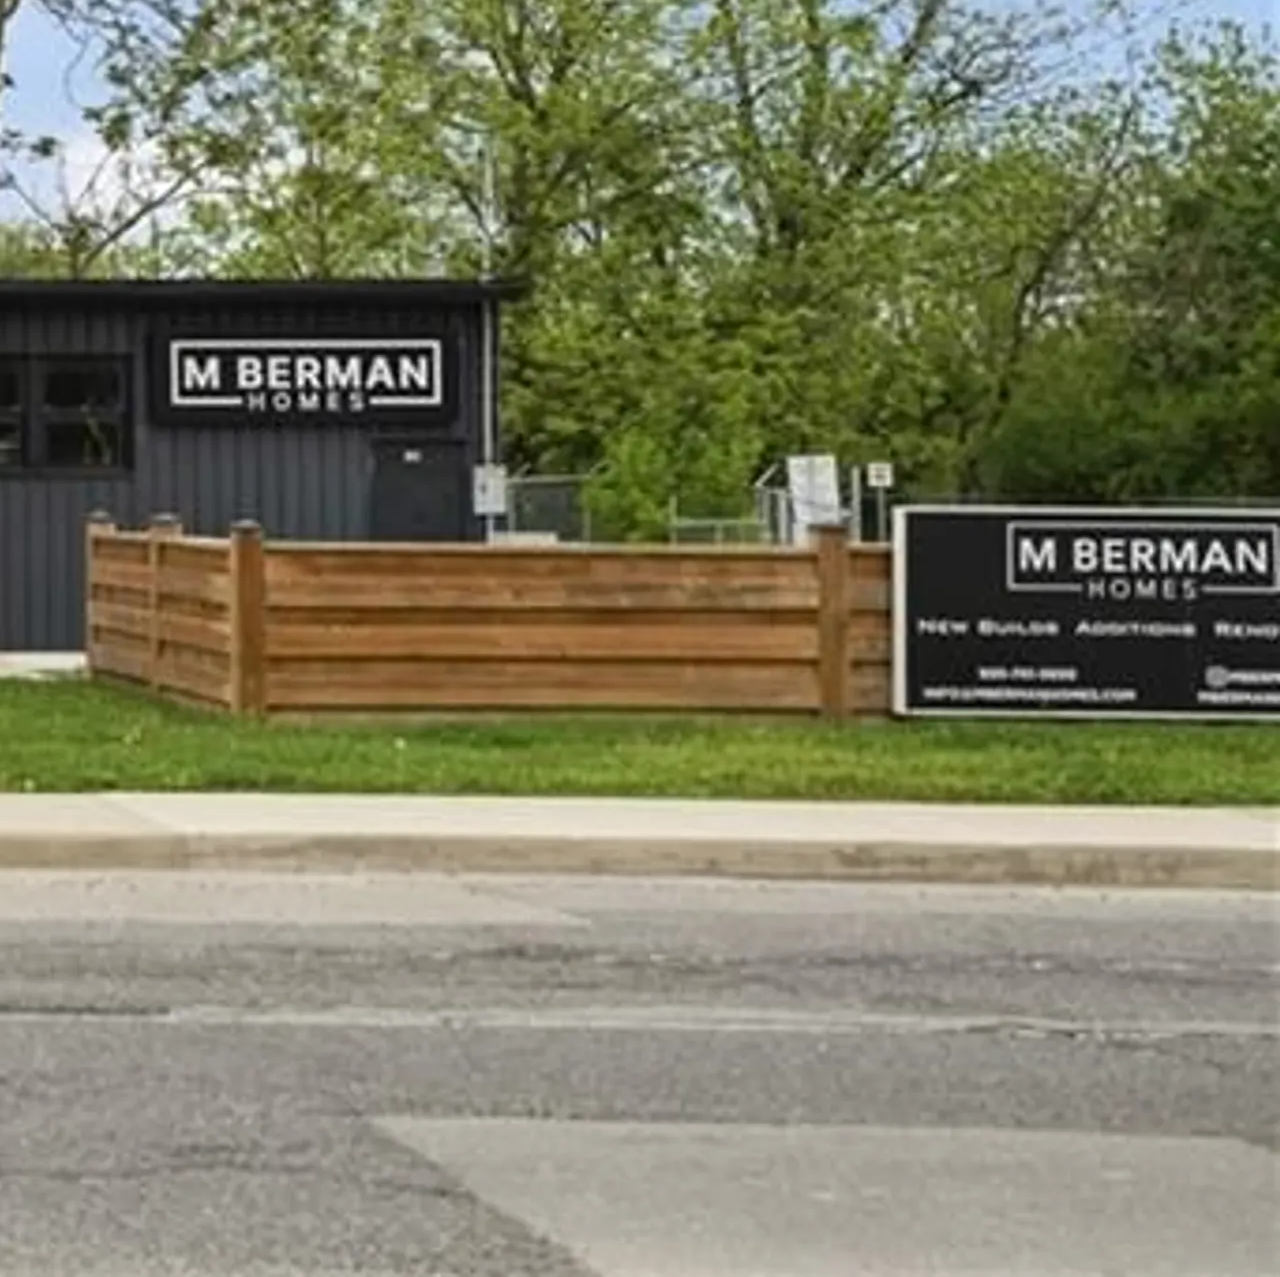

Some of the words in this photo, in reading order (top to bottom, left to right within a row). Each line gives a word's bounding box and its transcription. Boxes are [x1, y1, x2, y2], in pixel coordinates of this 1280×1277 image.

[183, 355, 220, 390] M
[238, 355, 429, 390] BERMAN
[247, 392, 365, 412] HOMES
[1018, 537, 1057, 573] M
[1072, 537, 1268, 574] BERMAN
[1087, 578, 1198, 600] HOMES
